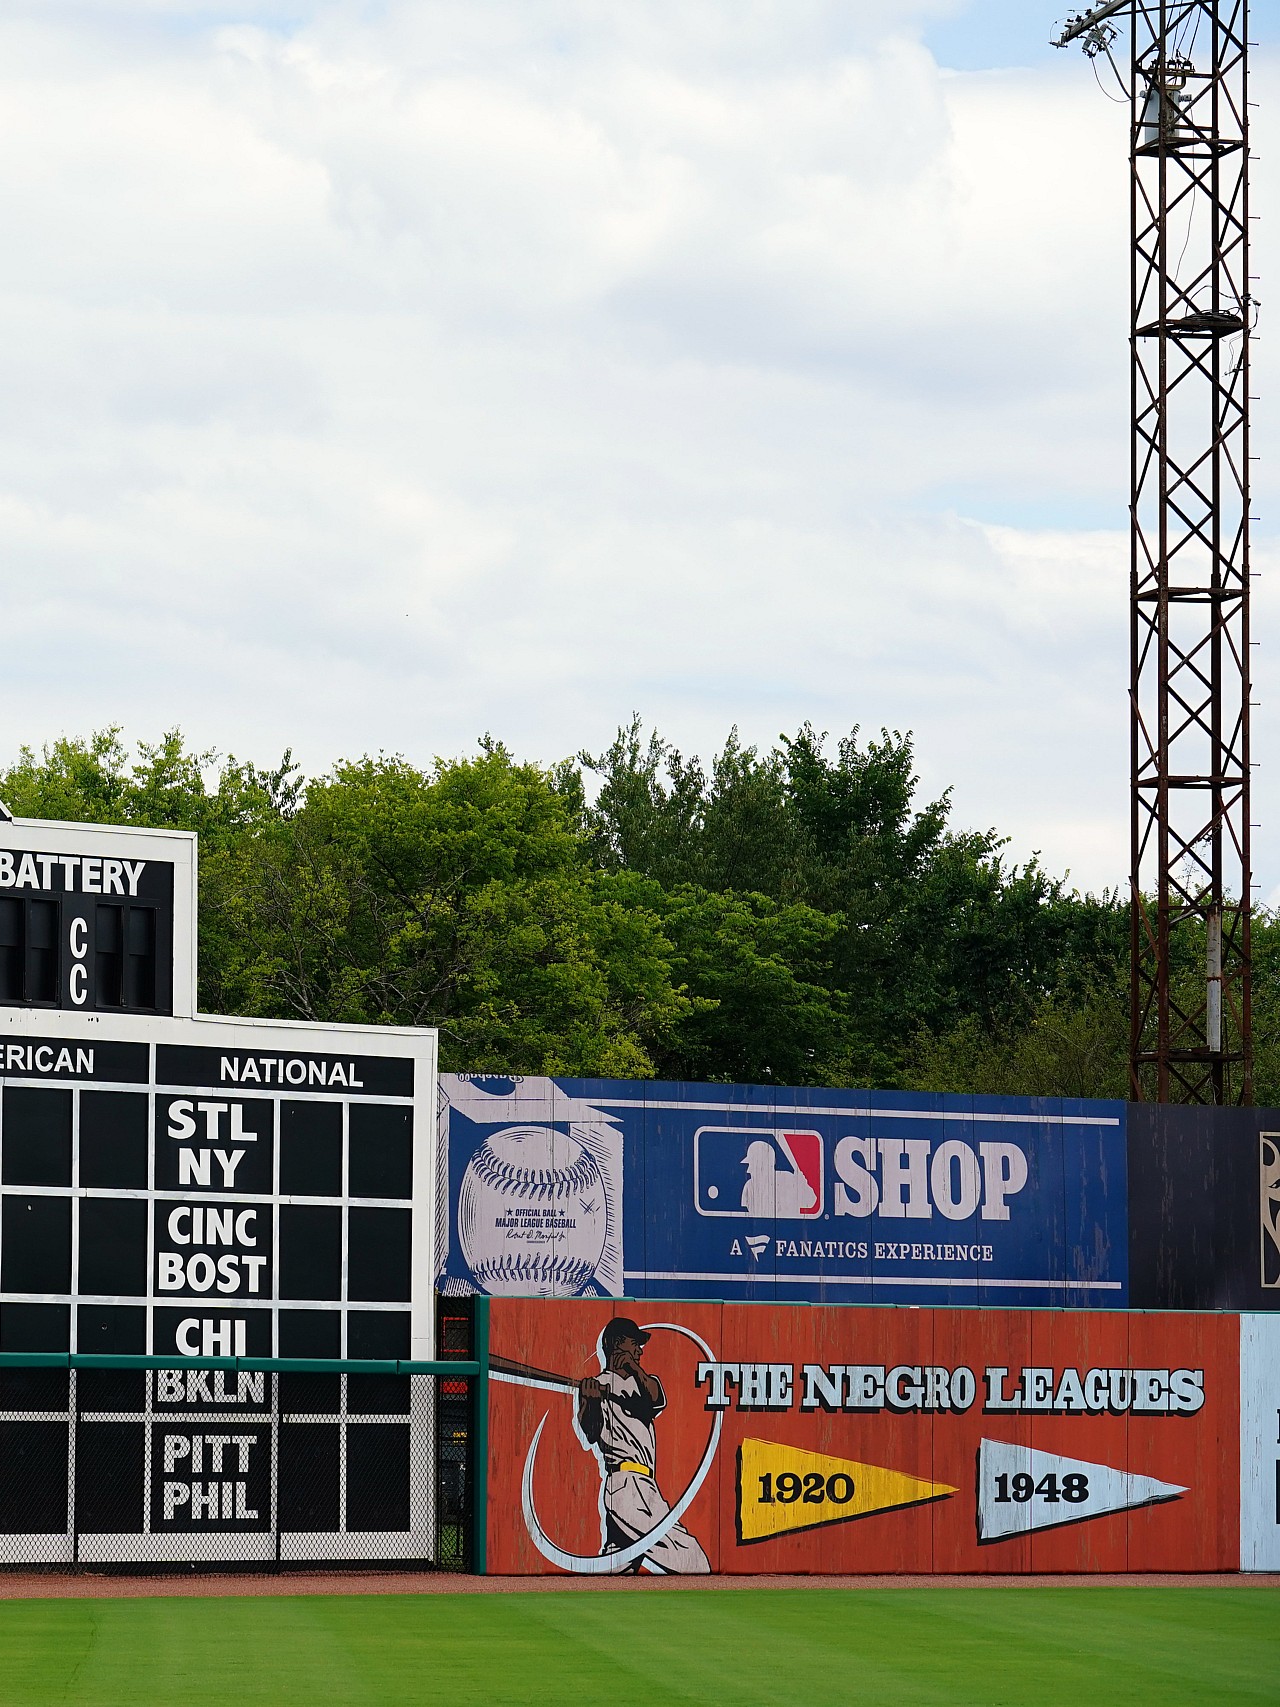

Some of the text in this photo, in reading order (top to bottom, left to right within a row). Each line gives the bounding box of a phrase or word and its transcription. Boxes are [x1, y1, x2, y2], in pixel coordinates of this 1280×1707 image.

[69, 918, 88, 958] C
[69, 964, 88, 1004] C
[221, 1057, 363, 1087] NATIONAL
[168, 1100, 257, 1141] STL
[179, 1148, 245, 1187] NY
[834, 1136, 1028, 1220] SHOP
[168, 1207, 256, 1246] CINC
[495, 1218, 576, 1229] MAJOR LEAGUE BASEBALL
[515, 1209, 557, 1217] OFFICIAL BALL
[730, 1240, 993, 1261] A FANATICS EXPERIENCE
[158, 1253, 266, 1292] BOST
[176, 1318, 245, 1356] CHI
[158, 1370, 264, 1403] BKLN
[695, 1361, 1206, 1417] THE NEGRO LEAGUES
[164, 1435, 258, 1473] PITT
[164, 1482, 259, 1519] PHIL
[758, 1474, 855, 1505] 1920
[995, 1474, 1090, 1505] 1948
